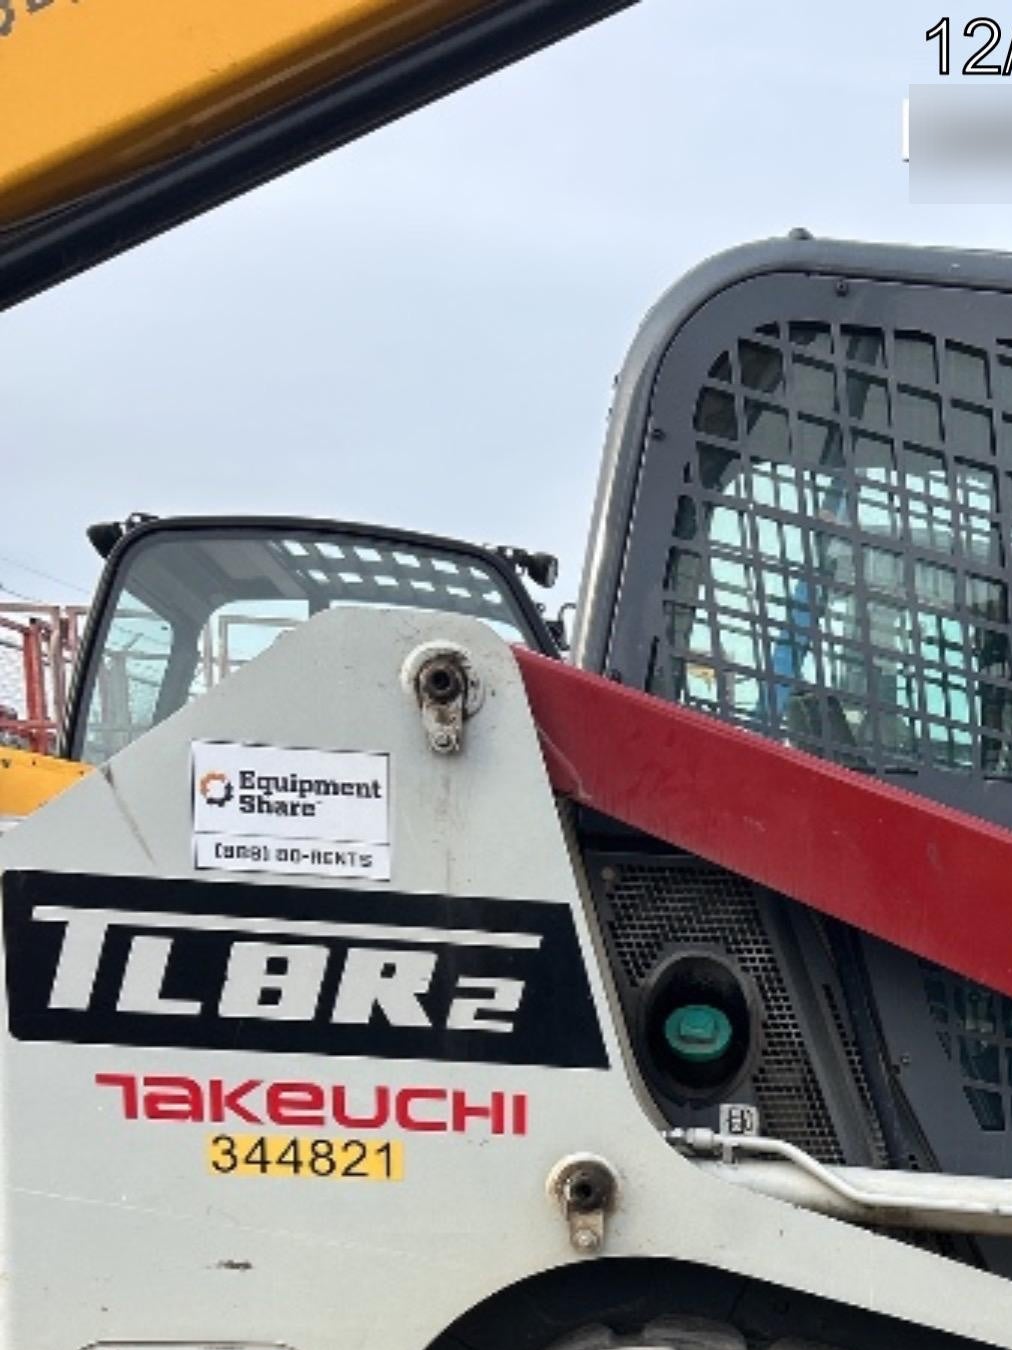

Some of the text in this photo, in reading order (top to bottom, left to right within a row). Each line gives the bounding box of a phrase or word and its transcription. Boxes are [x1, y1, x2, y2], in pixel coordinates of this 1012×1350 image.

[239, 770, 382, 799] Equipment
[239, 795, 316, 816] Share
[211, 1136, 395, 1177] 344821
